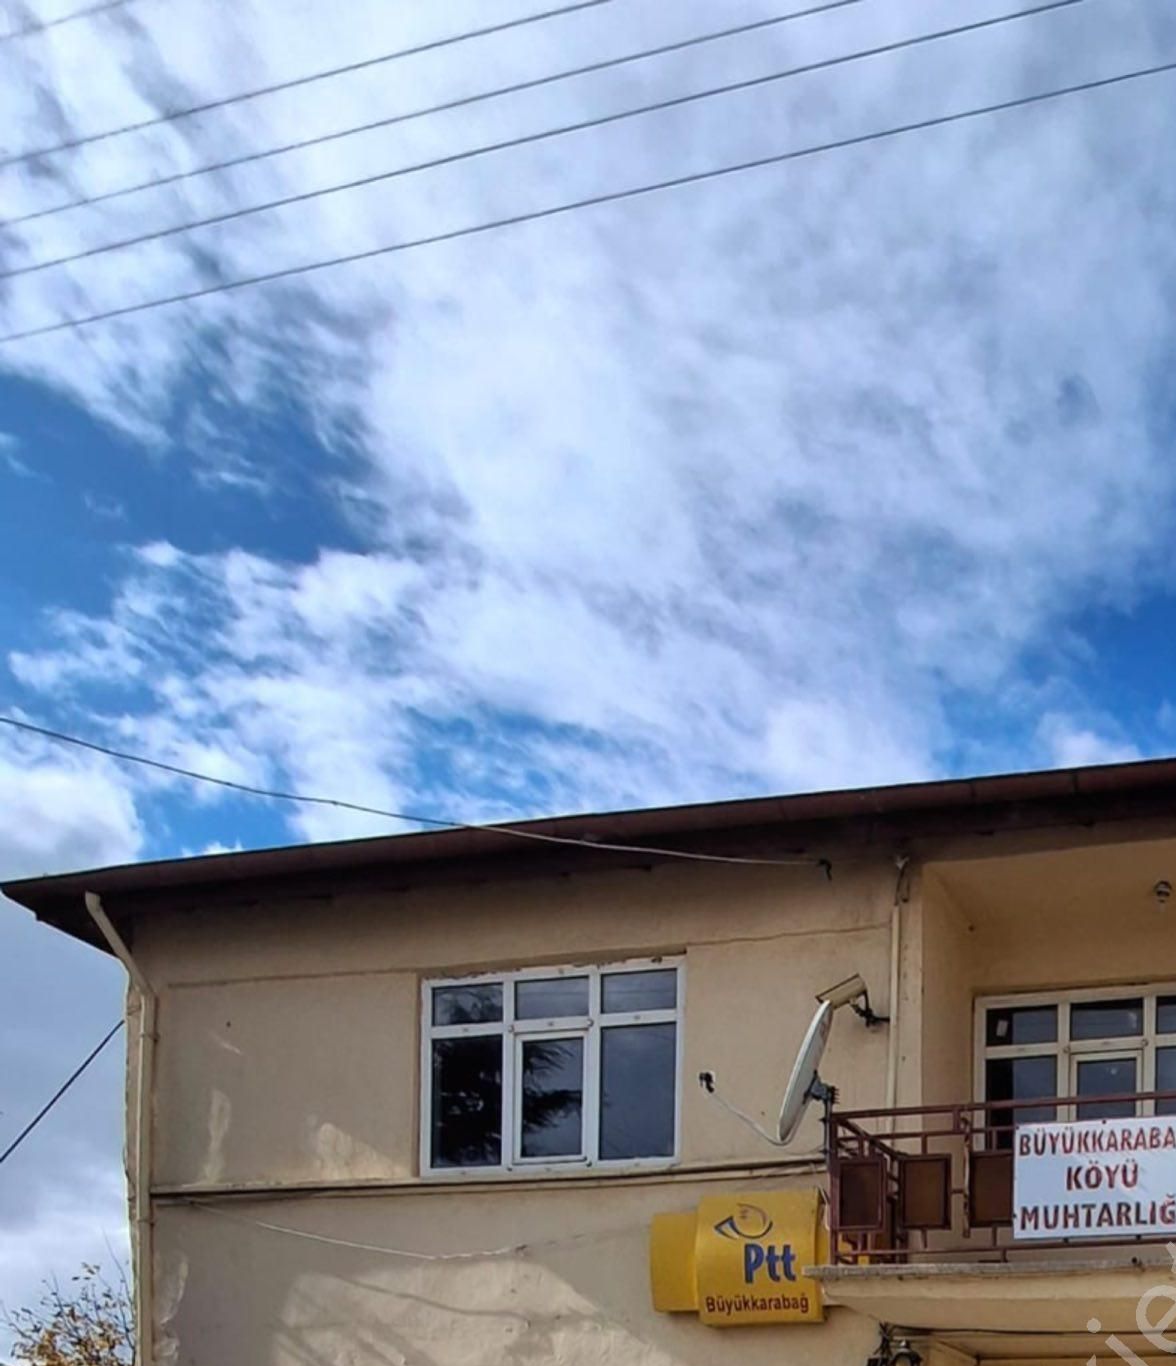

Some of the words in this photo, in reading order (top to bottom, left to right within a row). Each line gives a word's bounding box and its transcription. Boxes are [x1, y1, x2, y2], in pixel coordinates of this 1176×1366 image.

[1065, 1158, 1139, 1192] KÖYÜ
[744, 1243, 796, 1284] Ptt
[705, 1293, 809, 1316] Büyükkarabağ
